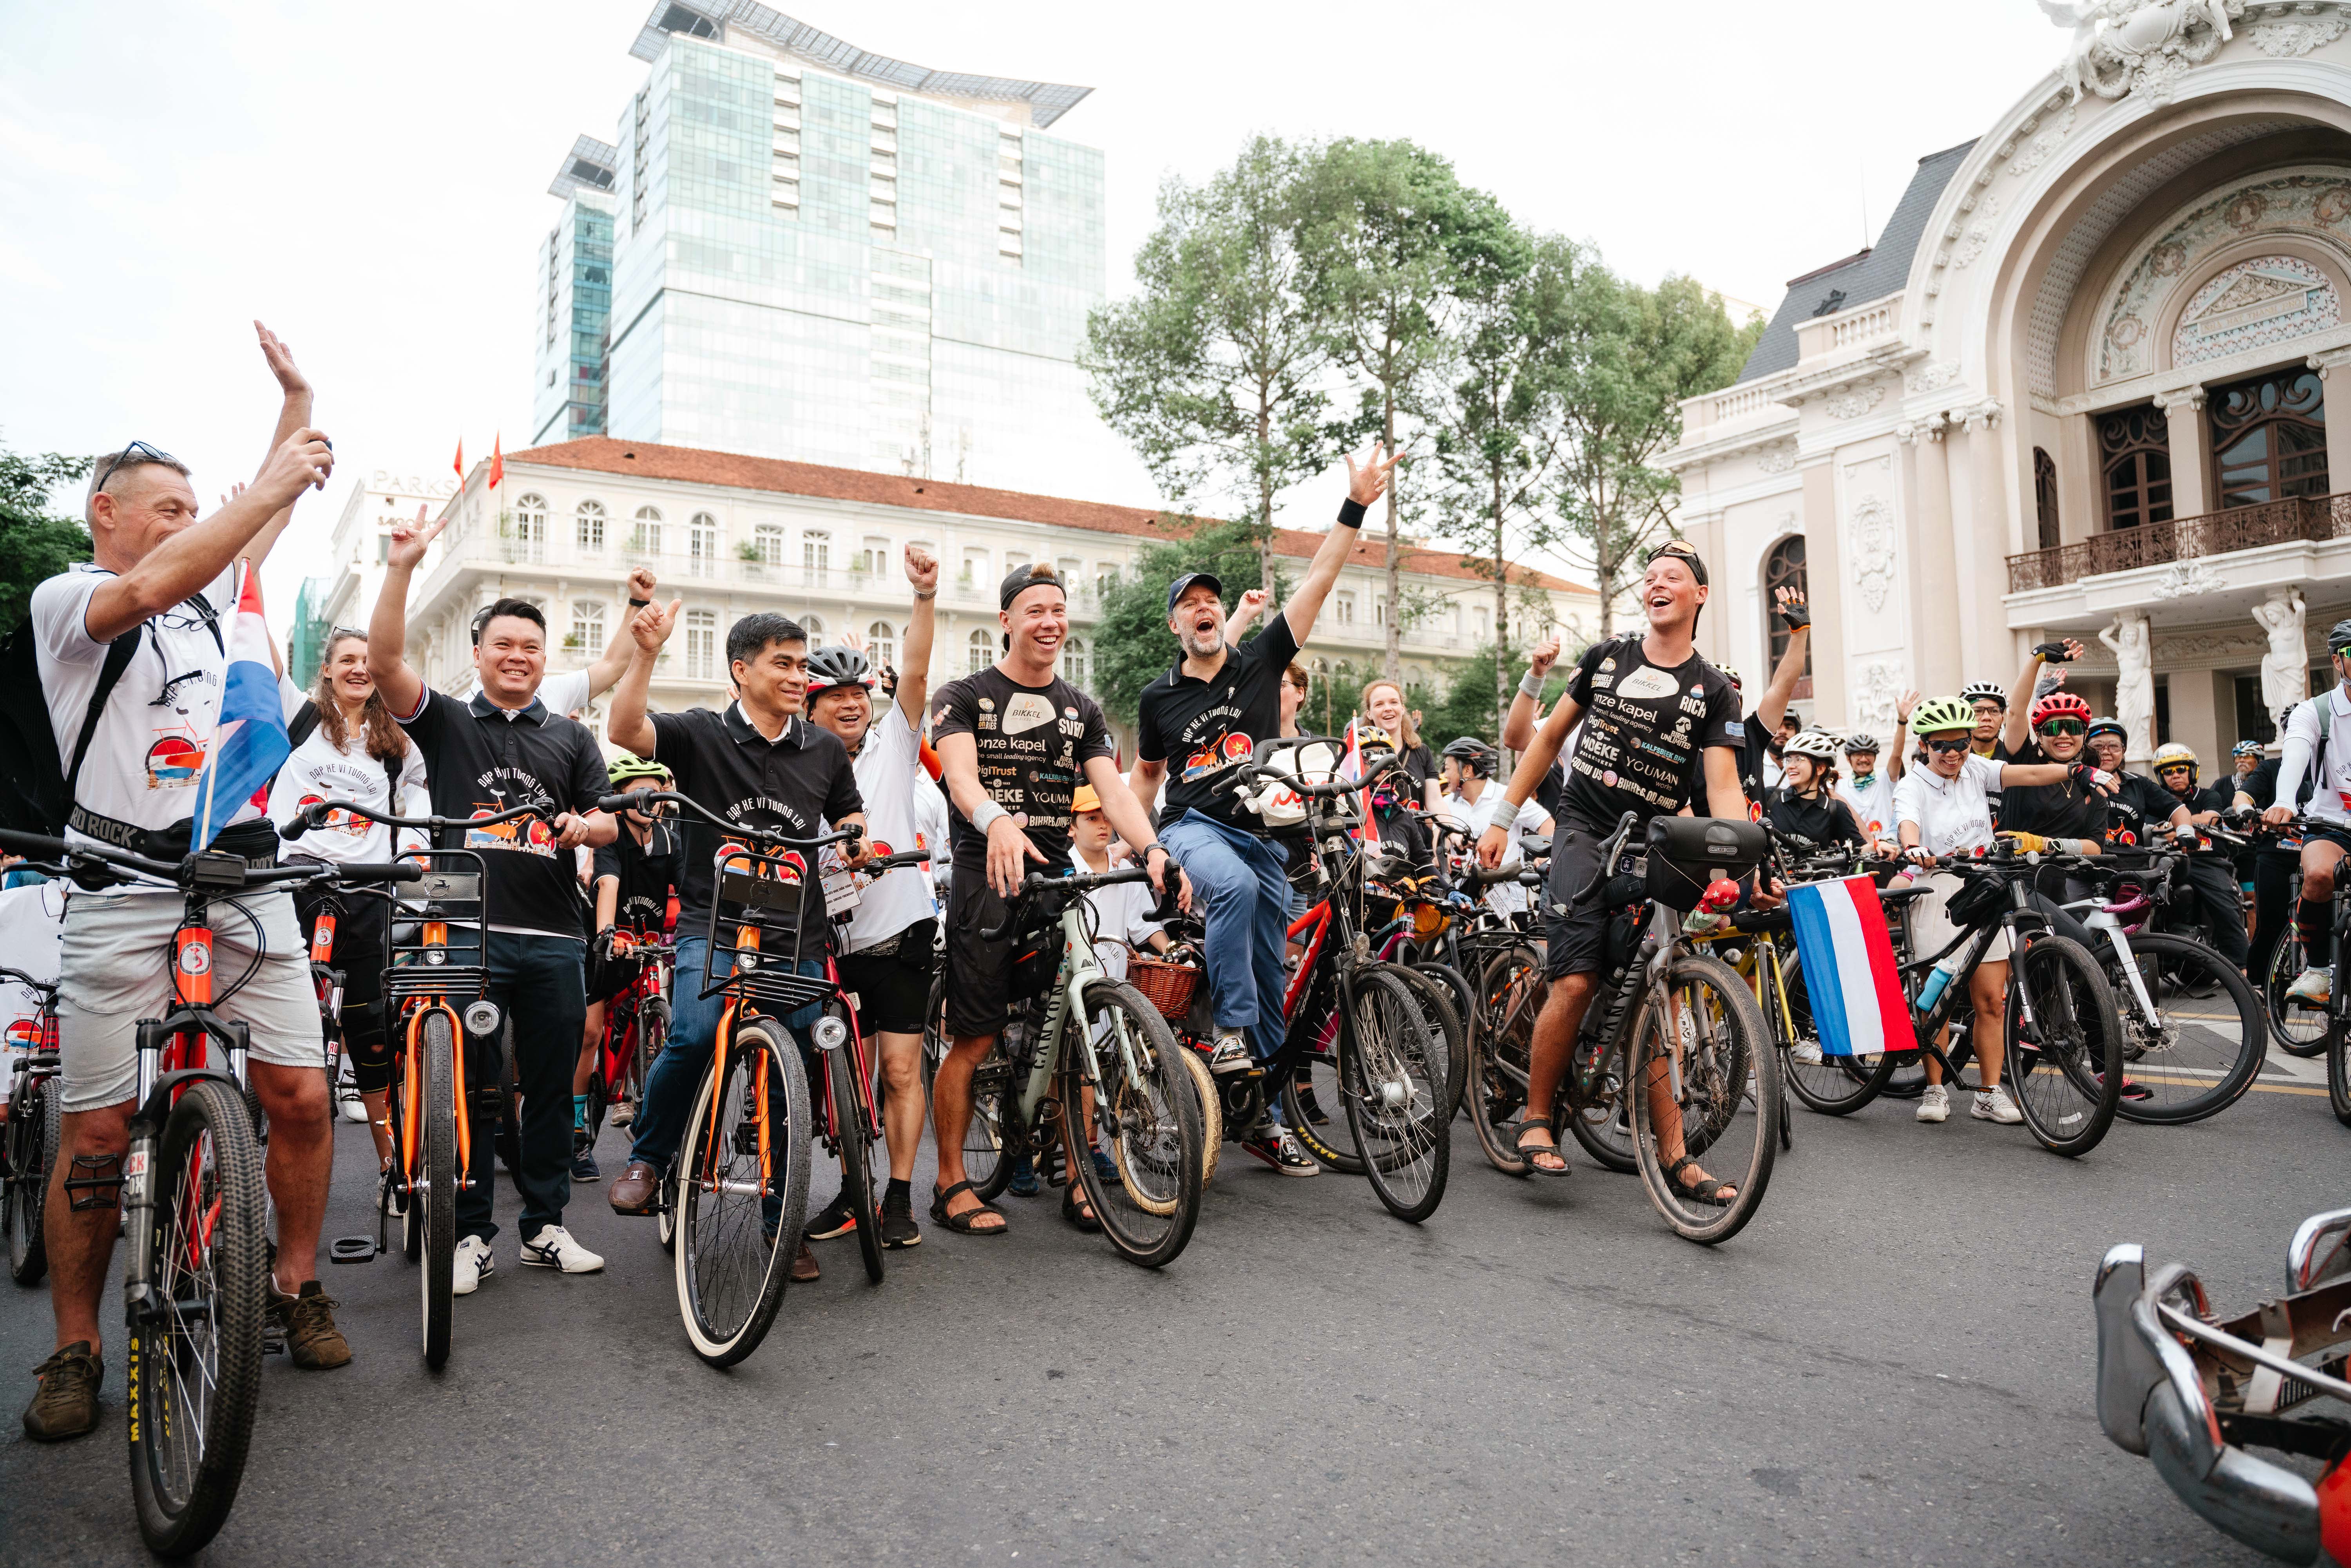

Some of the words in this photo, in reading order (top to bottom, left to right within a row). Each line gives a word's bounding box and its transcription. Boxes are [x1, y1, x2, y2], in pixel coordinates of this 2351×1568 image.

[1632, 679, 1662, 692] BIKKEL
[1012, 710, 1042, 718] BIKKEL
[1594, 693, 1616, 707] onze
[1618, 699, 1658, 723] kapel
[1588, 715, 1619, 735] DigiTrust
[1596, 708, 1608, 717] small
[1609, 712, 1630, 724] leading
[1630, 720, 1654, 733] agency
[978, 738, 1007, 749] onze
[1011, 737, 1047, 753] kapel
[1661, 733, 1691, 750] UNLIMITED
[1670, 730, 1688, 742] BIRDS
[1581, 735, 1620, 761] MOEKE
[1641, 742, 1674, 759] KALFSBEEK
[1674, 754, 1686, 764] BHV
[326, 764, 336, 773] XE
[1592, 768, 1603, 781] US
[1627, 756, 1678, 786] YOUMAN
[986, 789, 1024, 802] OEKE
[1655, 781, 1673, 791] works
[742, 798, 755, 811] XE
[1032, 792, 1071, 804] YOUMA
[69, 805, 86, 831] RD
[87, 814, 138, 848] ROCK
[1299, 969, 1317, 1018] sparta
[1598, 961, 1646, 1045] CANYON
[1034, 983, 1065, 1069] CANYON
[2243, 1070, 2256, 1088] PIRELLI
[1298, 1127, 1338, 1160] MAXXIS
[129, 1154, 144, 1173] CK
[129, 1175, 145, 1195] OX
[130, 1337, 139, 1442] MAXXIS
